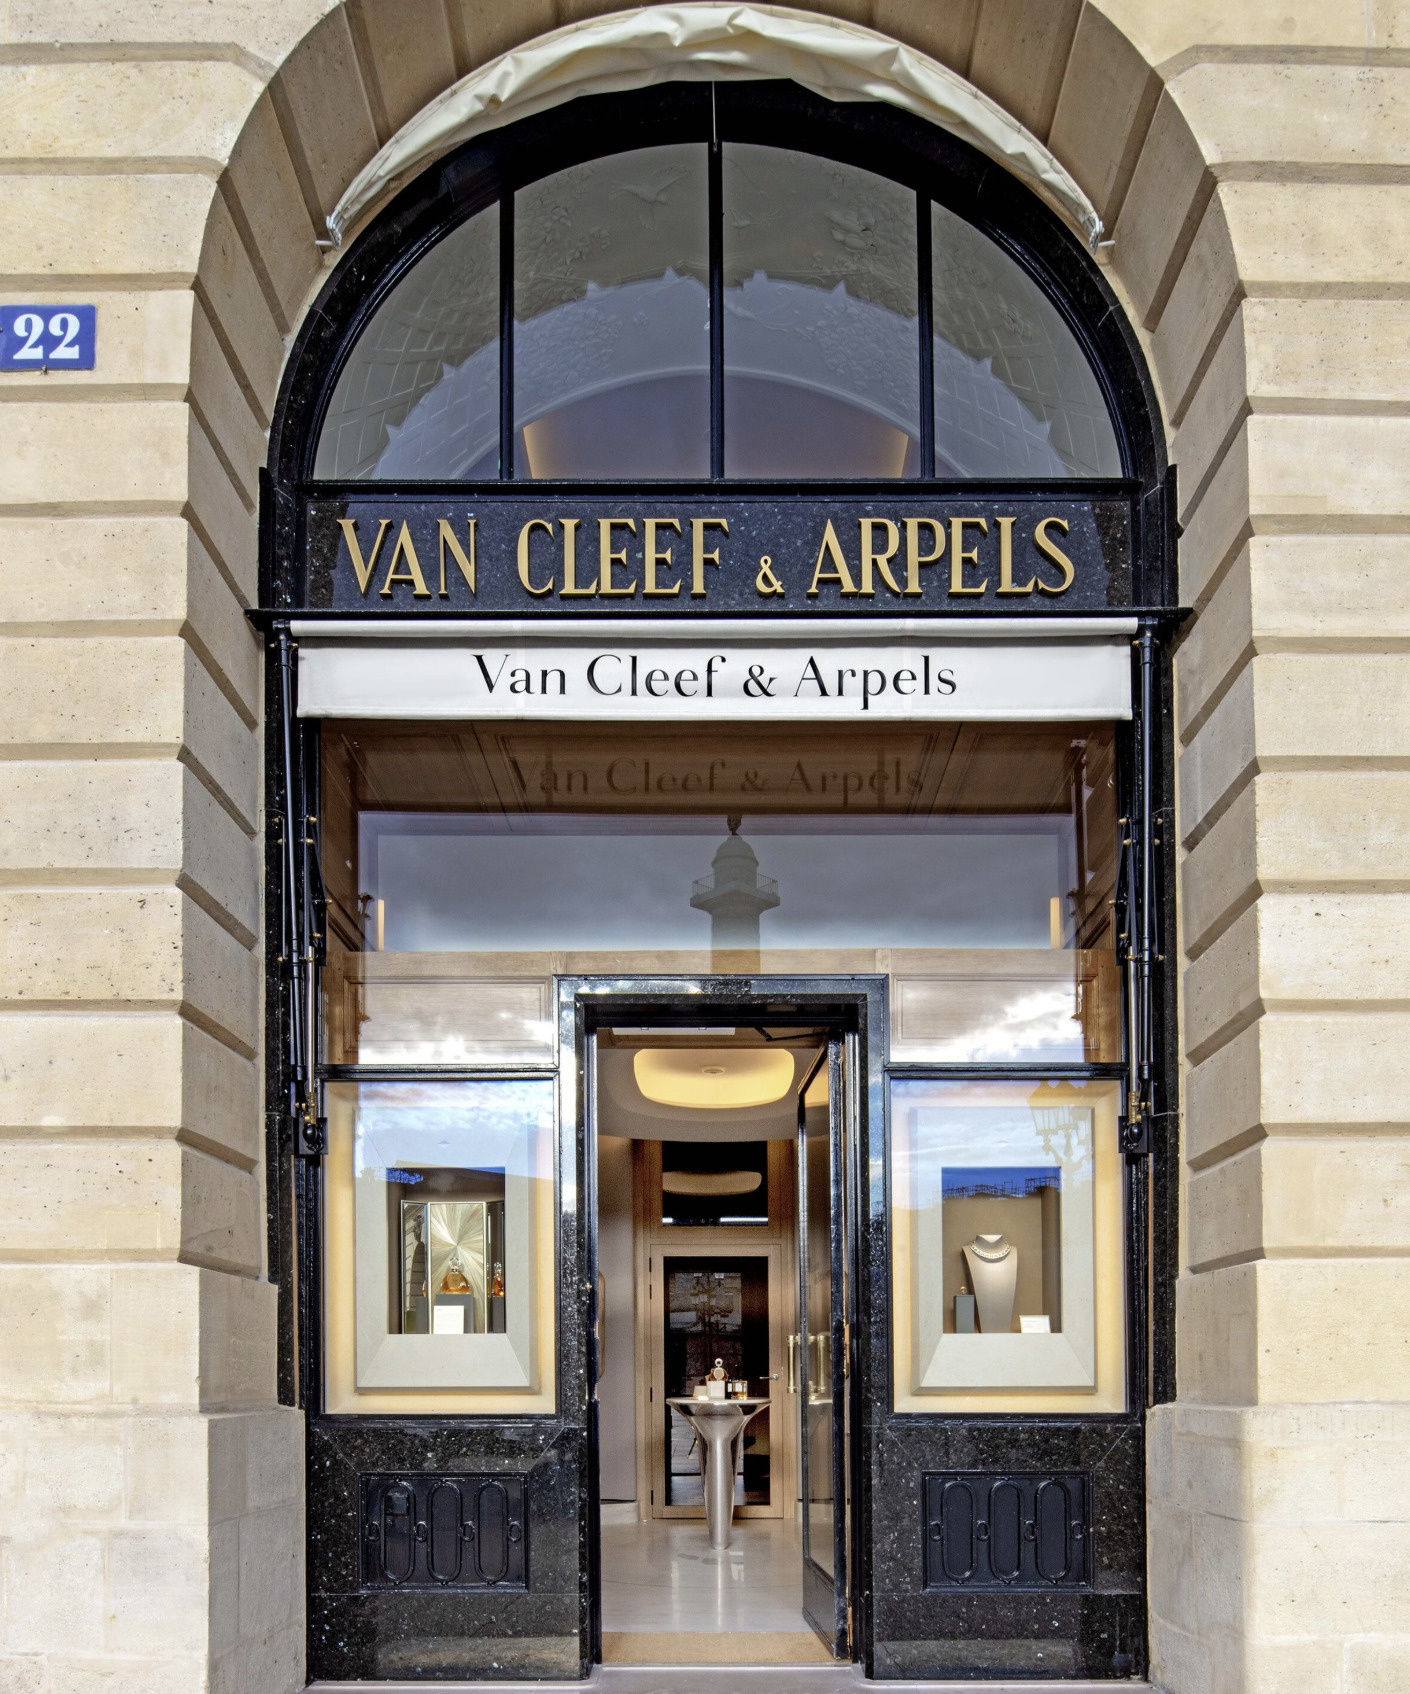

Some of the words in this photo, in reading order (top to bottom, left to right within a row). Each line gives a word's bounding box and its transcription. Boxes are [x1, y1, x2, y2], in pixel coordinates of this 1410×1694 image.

[13, 313, 80, 359] 22
[336, 518, 477, 597] VAN
[516, 518, 730, 598] CLEEF
[755, 555, 785, 597] &
[806, 516, 1075, 597] ARPELS
[472, 653, 567, 695] Van
[586, 654, 727, 698] Cleef
[742, 663, 778, 698] &
[793, 654, 957, 710] Arpels
[509, 755, 589, 795] Van
[605, 756, 727, 795] Cleef
[739, 766, 770, 795] &
[785, 755, 923, 808] Arpels
